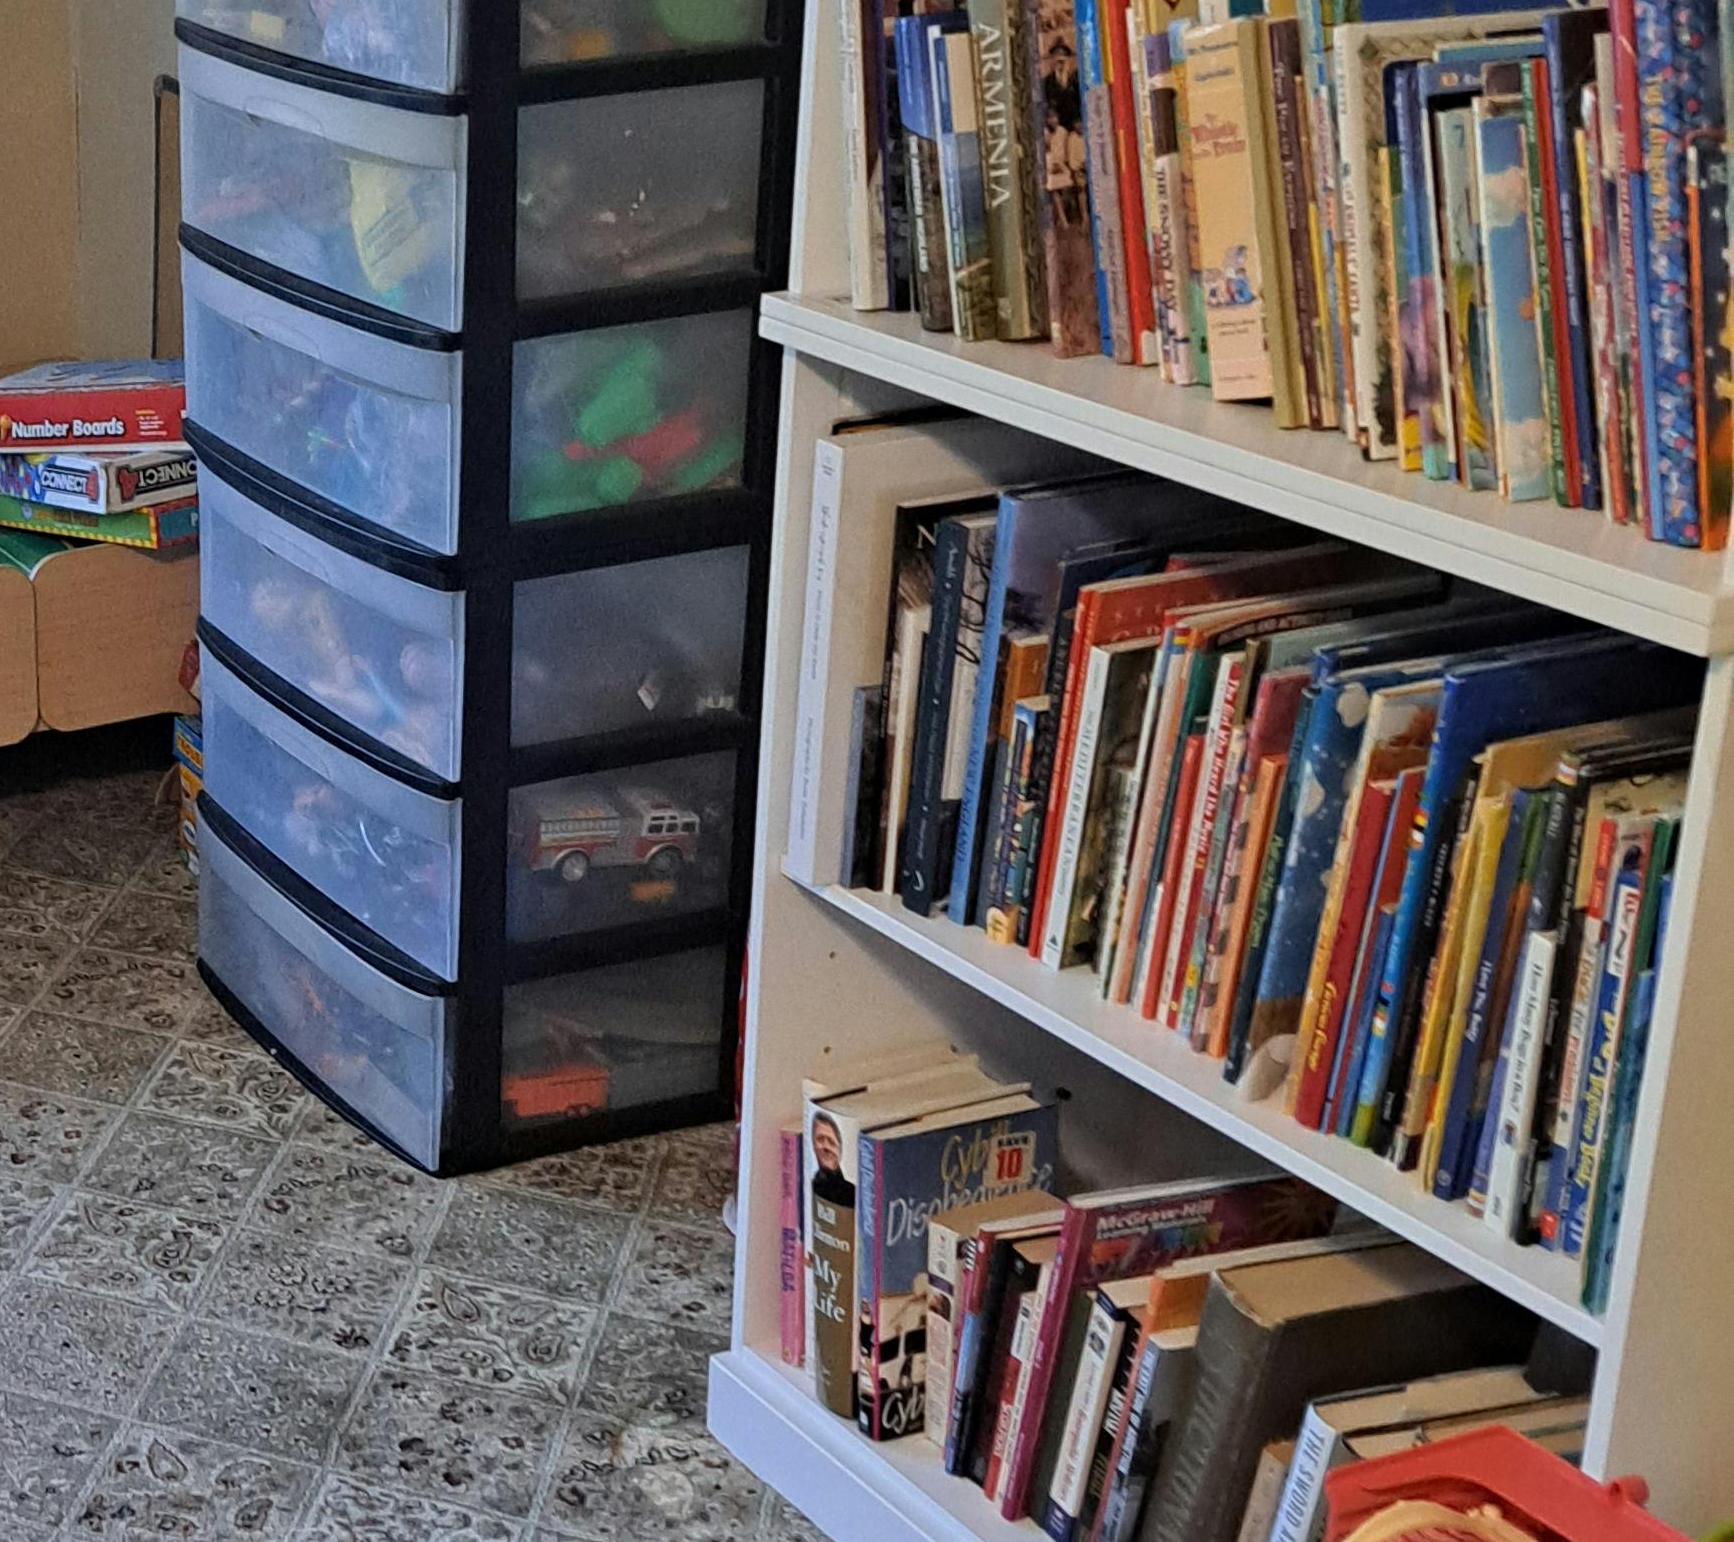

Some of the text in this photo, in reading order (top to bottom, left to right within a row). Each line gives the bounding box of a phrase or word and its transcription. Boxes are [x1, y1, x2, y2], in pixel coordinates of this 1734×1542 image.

[977, 23, 1011, 208] ARMENIA
[1153, 167, 1170, 201] THE
[11, 420, 69, 439] Number
[72, 417, 125, 437] Boards
[41, 469, 88, 494] CONNECT
[137, 460, 197, 489] ONNECT
[1228, 678, 1242, 700] The
[1223, 703, 1238, 727] Girl
[1217, 729, 1233, 755] Who
[1531, 962, 1545, 992] How
[996, 1148, 1023, 1181] 10
[1307, 1430, 1326, 1462] THE
[1284, 1464, 1317, 1526] SWORD
